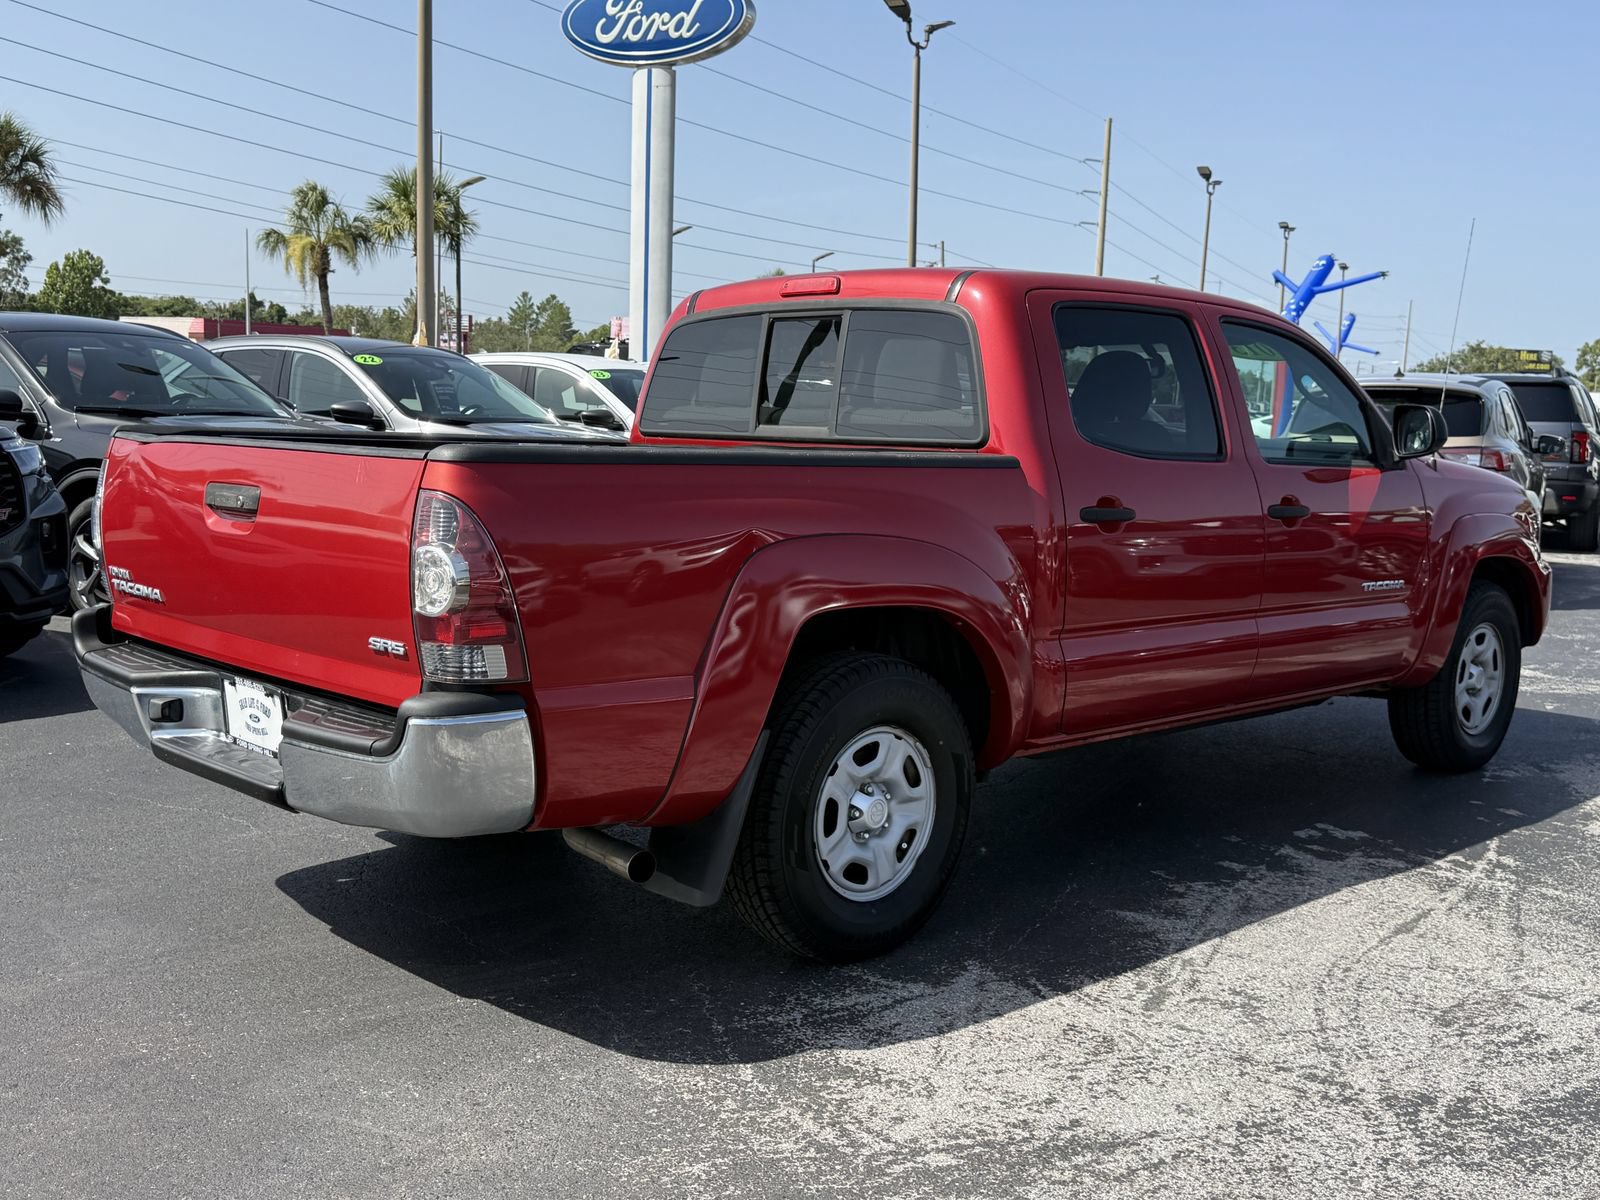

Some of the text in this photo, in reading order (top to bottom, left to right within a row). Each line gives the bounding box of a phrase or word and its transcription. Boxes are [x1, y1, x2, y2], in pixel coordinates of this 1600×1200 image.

[595, 0, 703, 43] Ford
[360, 355, 377, 363] 22
[108, 565, 132, 580] TOYOTA
[111, 578, 163, 602] TACOMA
[1361, 579, 1405, 592] TACOMA
[368, 636, 406, 656] SR5
[248, 743, 264, 753] SPRING
[263, 748, 273, 758] HILL
